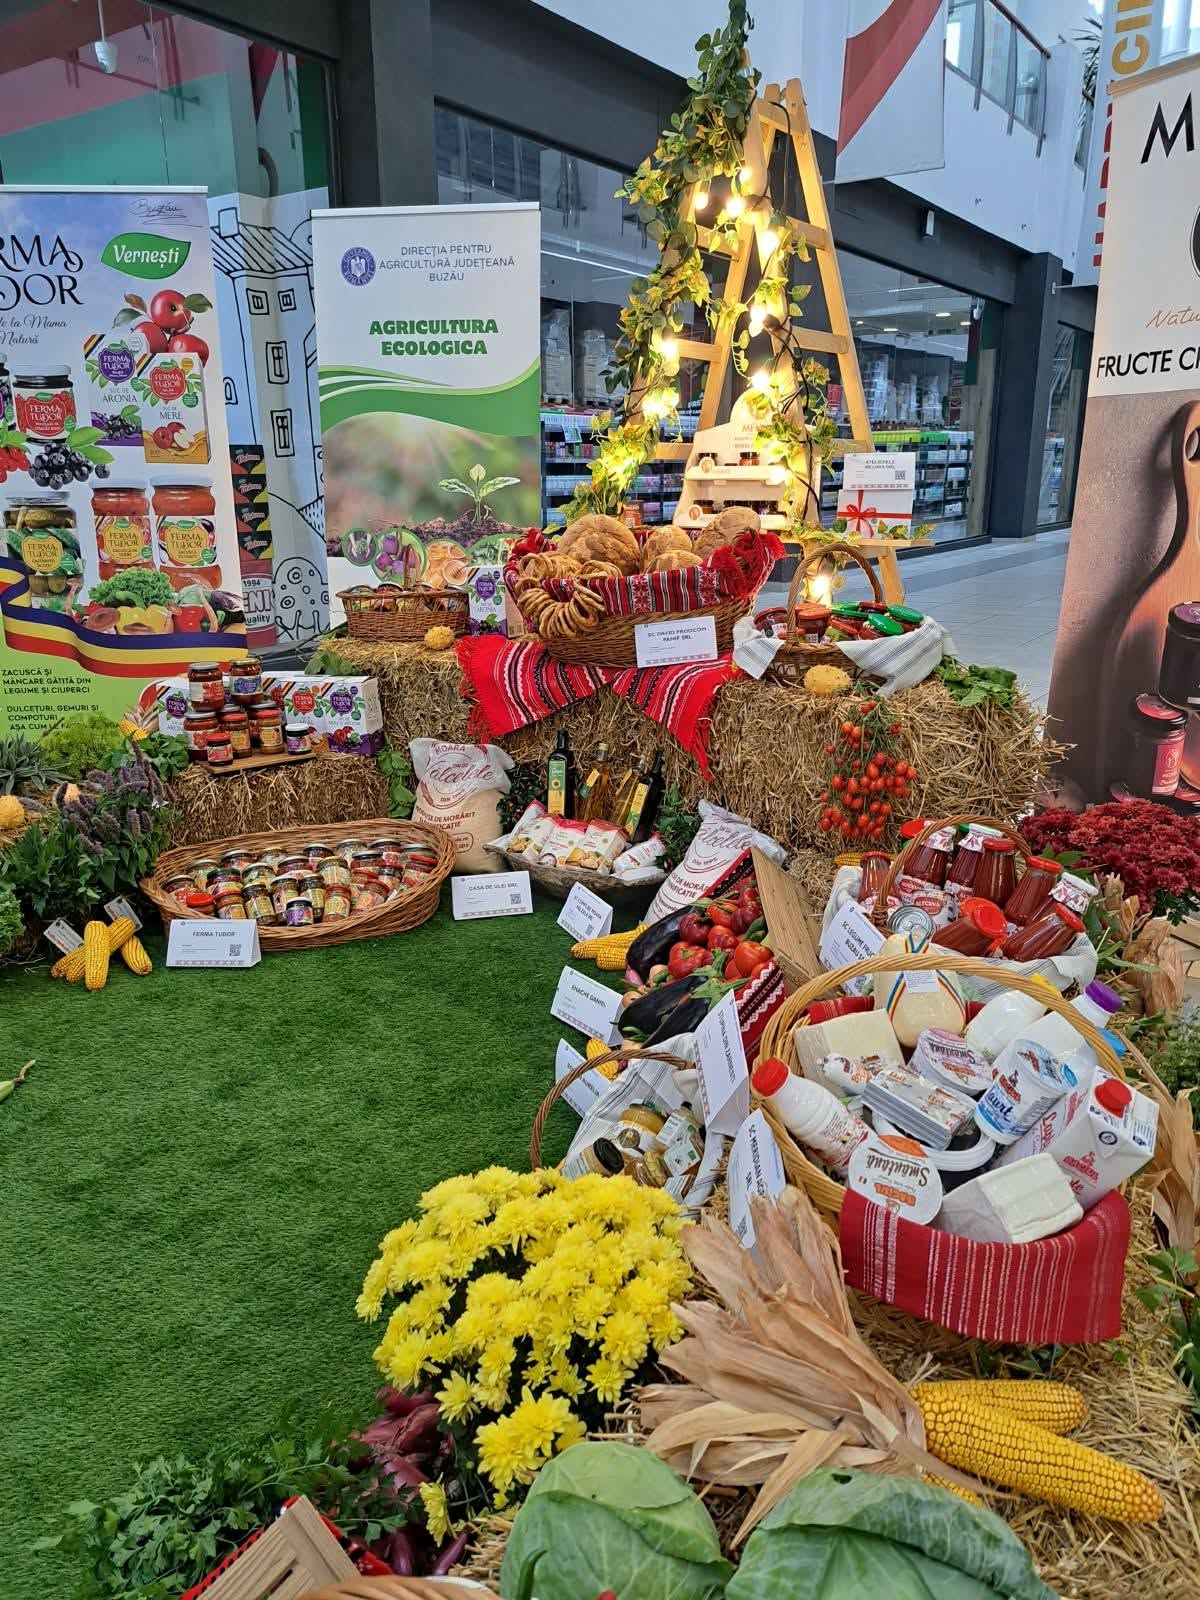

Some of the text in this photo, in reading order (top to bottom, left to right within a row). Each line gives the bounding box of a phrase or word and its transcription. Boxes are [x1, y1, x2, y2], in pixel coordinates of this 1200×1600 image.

[400, 244, 492, 257] DIRECȚIA PENTRU
[113, 244, 180, 269] Vernești
[379, 256, 515, 269] AGRICULTURĂ JUDEȚEANĂ
[429, 271, 465, 281] BUZĂU
[24, 314, 68, 328] Mama
[369, 319, 499, 335] AGRICULTURA
[381, 340, 488, 356] ECOLOGICA
[103, 355, 131, 363] FERMA
[1096, 349, 1173, 378] FRUCTE
[103, 363, 130, 371] TUDOR
[30, 405, 62, 413] FERMA
[31, 413, 62, 422] TUDOR
[160, 411, 184, 420] MERE
[109, 532, 140, 540] FERMA
[243, 579, 261, 587] 1994
[2, 668, 52, 677] ZACUSCĂ ȘI
[3, 677, 45, 685] MÂNCARE
[46, 676, 75, 684] GĂTITĂ
[41, 687, 50, 695] ȘI
[10, 723, 26, 731] AȘA
[847, 926, 865, 948] LEGUME
[750, 1135, 762, 1180] MERIDIAN
